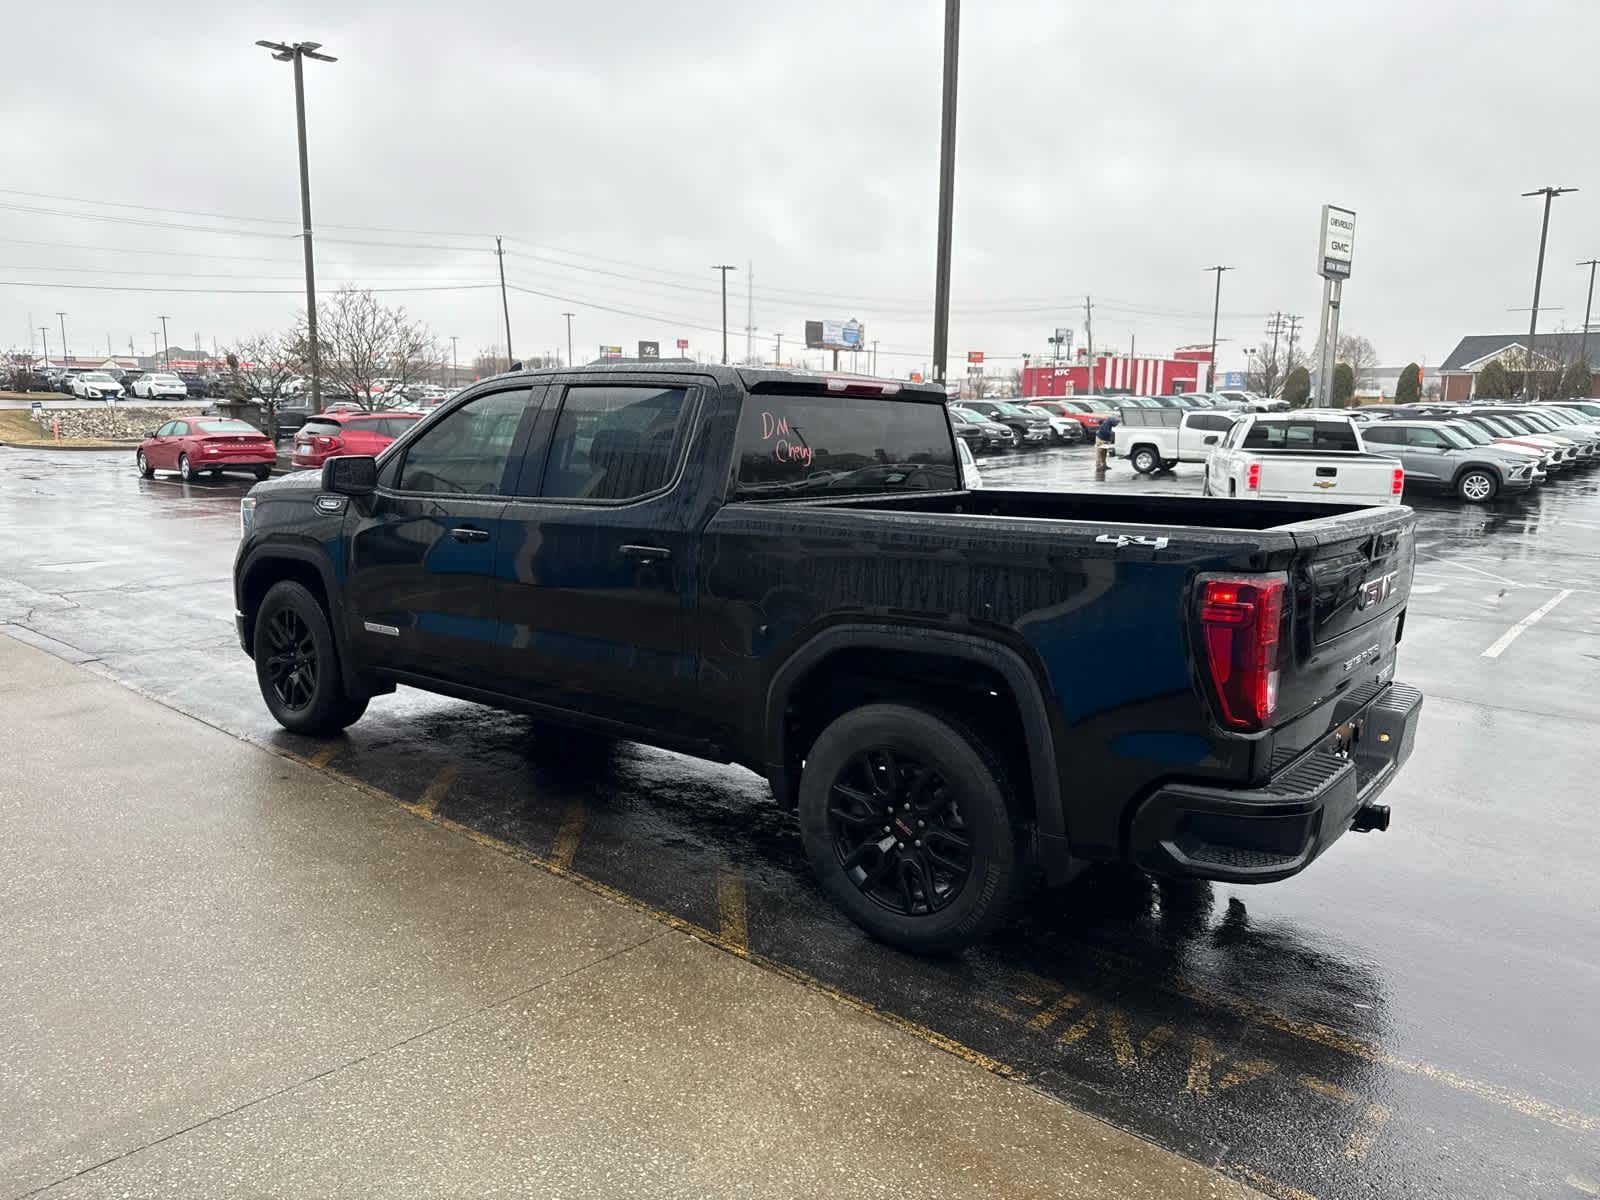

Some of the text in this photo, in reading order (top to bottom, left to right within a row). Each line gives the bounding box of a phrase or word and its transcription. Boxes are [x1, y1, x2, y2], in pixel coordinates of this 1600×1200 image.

[1331, 241, 1349, 253] GMC
[1054, 368, 1070, 377] KFC
[1358, 570, 1398, 612] GMC
